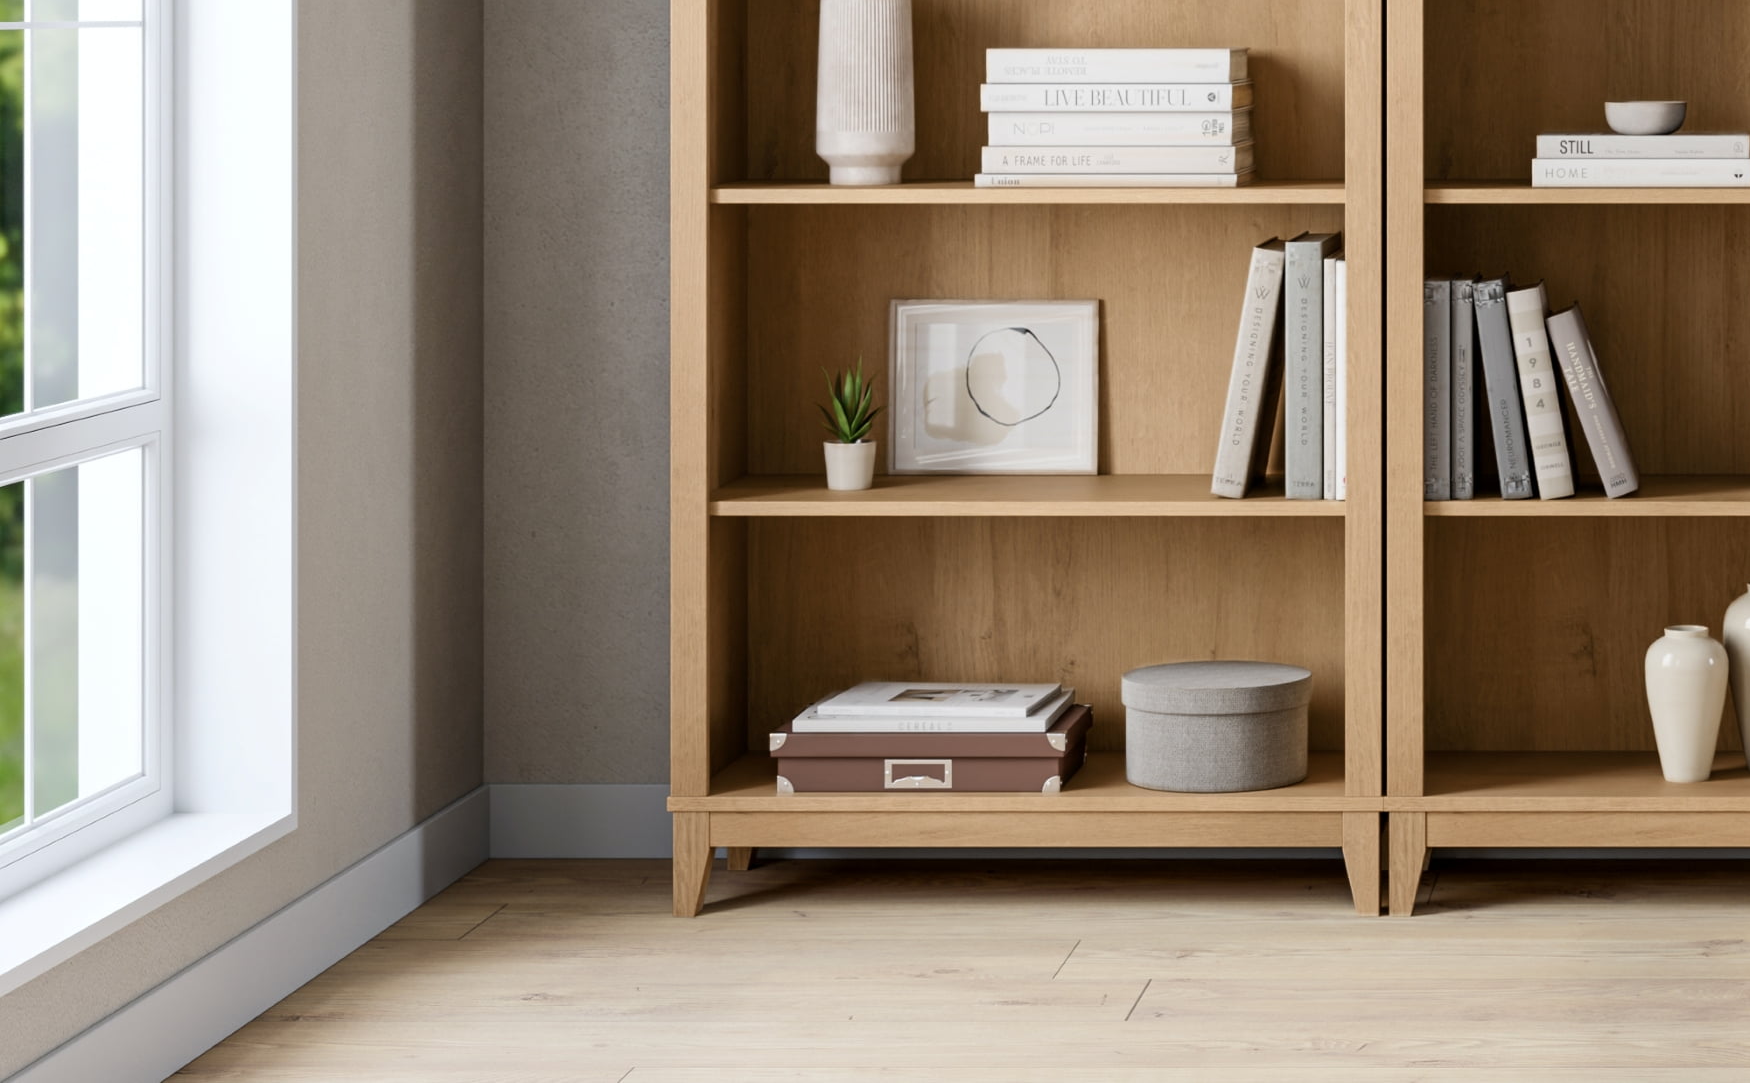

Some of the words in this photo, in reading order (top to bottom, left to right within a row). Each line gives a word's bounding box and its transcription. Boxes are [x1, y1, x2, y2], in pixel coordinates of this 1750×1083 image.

[1044, 90, 1085, 106] LIVE
[1091, 90, 1191, 106] BEAUTIFUL
[1560, 140, 1594, 154] STILL
[1002, 156, 1008, 166] A
[1014, 156, 1045, 166] FRAME
[1050, 156, 1068, 166] FOR
[1072, 156, 1091, 166] LIFE
[1545, 168, 1588, 178] HOME
[1246, 307, 1263, 366] DESIGNING
[1241, 374, 1252, 402] YOUR
[1565, 368, 1580, 393] TALE
[1566, 342, 1597, 410] HANDMAID'S
[1430, 386, 1438, 398] OF
[1430, 402, 1438, 428] HAND
[1232, 410, 1245, 446] WORLD
[1500, 399, 1516, 469] NEUROMANCER
